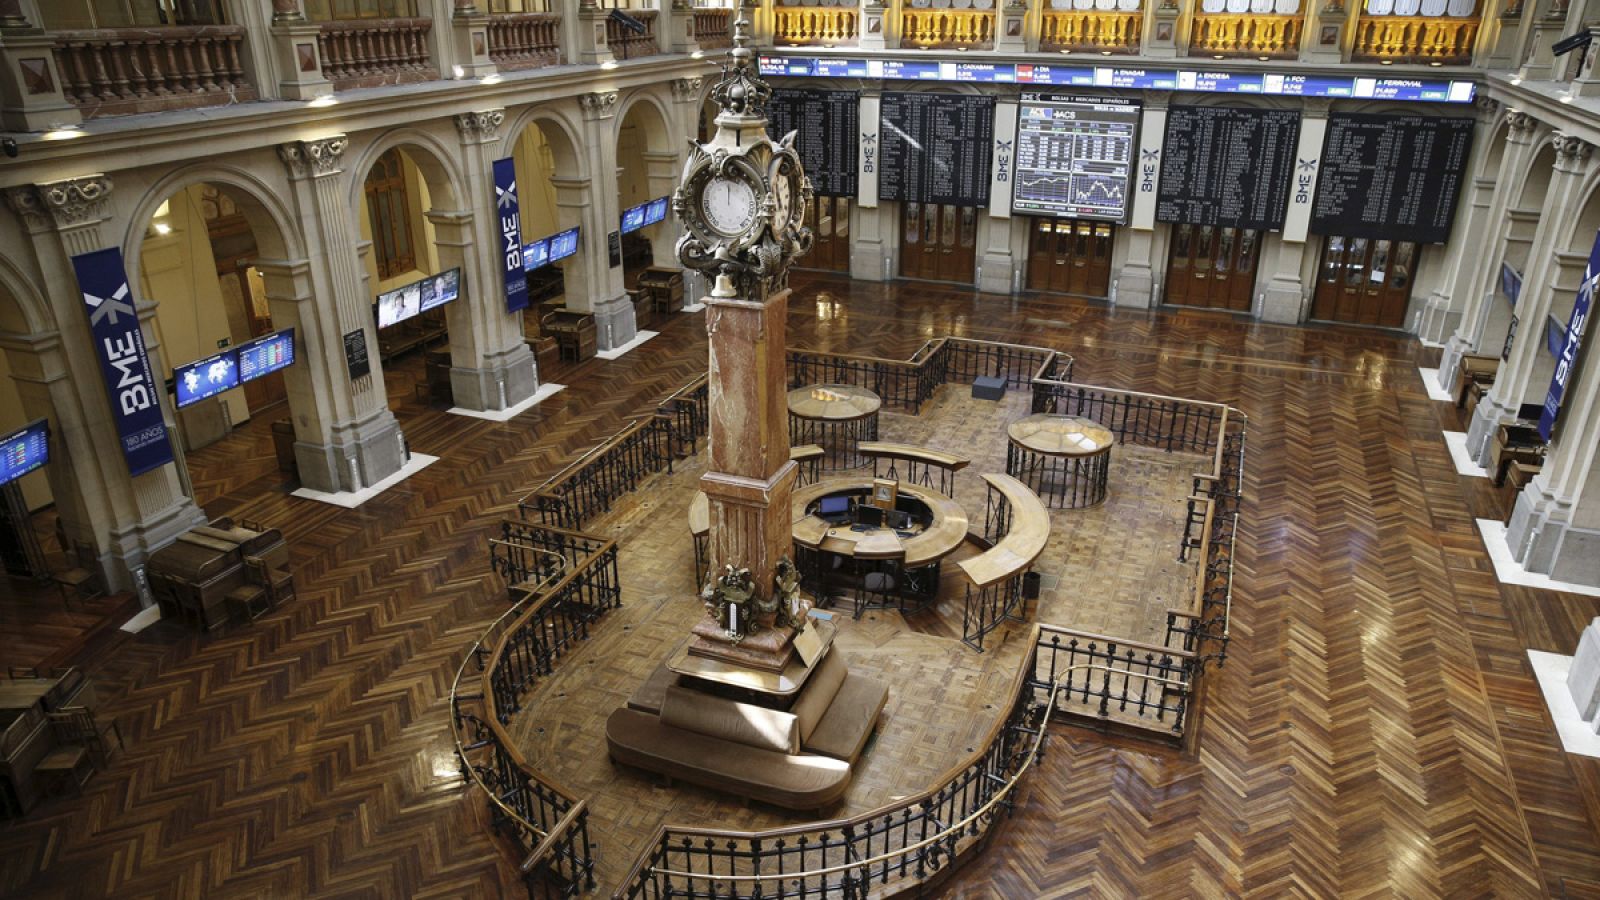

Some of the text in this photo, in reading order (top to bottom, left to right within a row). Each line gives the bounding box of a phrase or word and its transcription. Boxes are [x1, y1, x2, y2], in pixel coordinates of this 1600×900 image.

[1383, 80, 1423, 88] FERROVIAL
[864, 148, 874, 173] BME
[996, 154, 1009, 182] BME
[1141, 164, 1156, 192] BME
[1296, 174, 1312, 204] BME
[502, 214, 520, 271] BME
[1556, 308, 1585, 386] BME
[104, 331, 150, 416] BME
